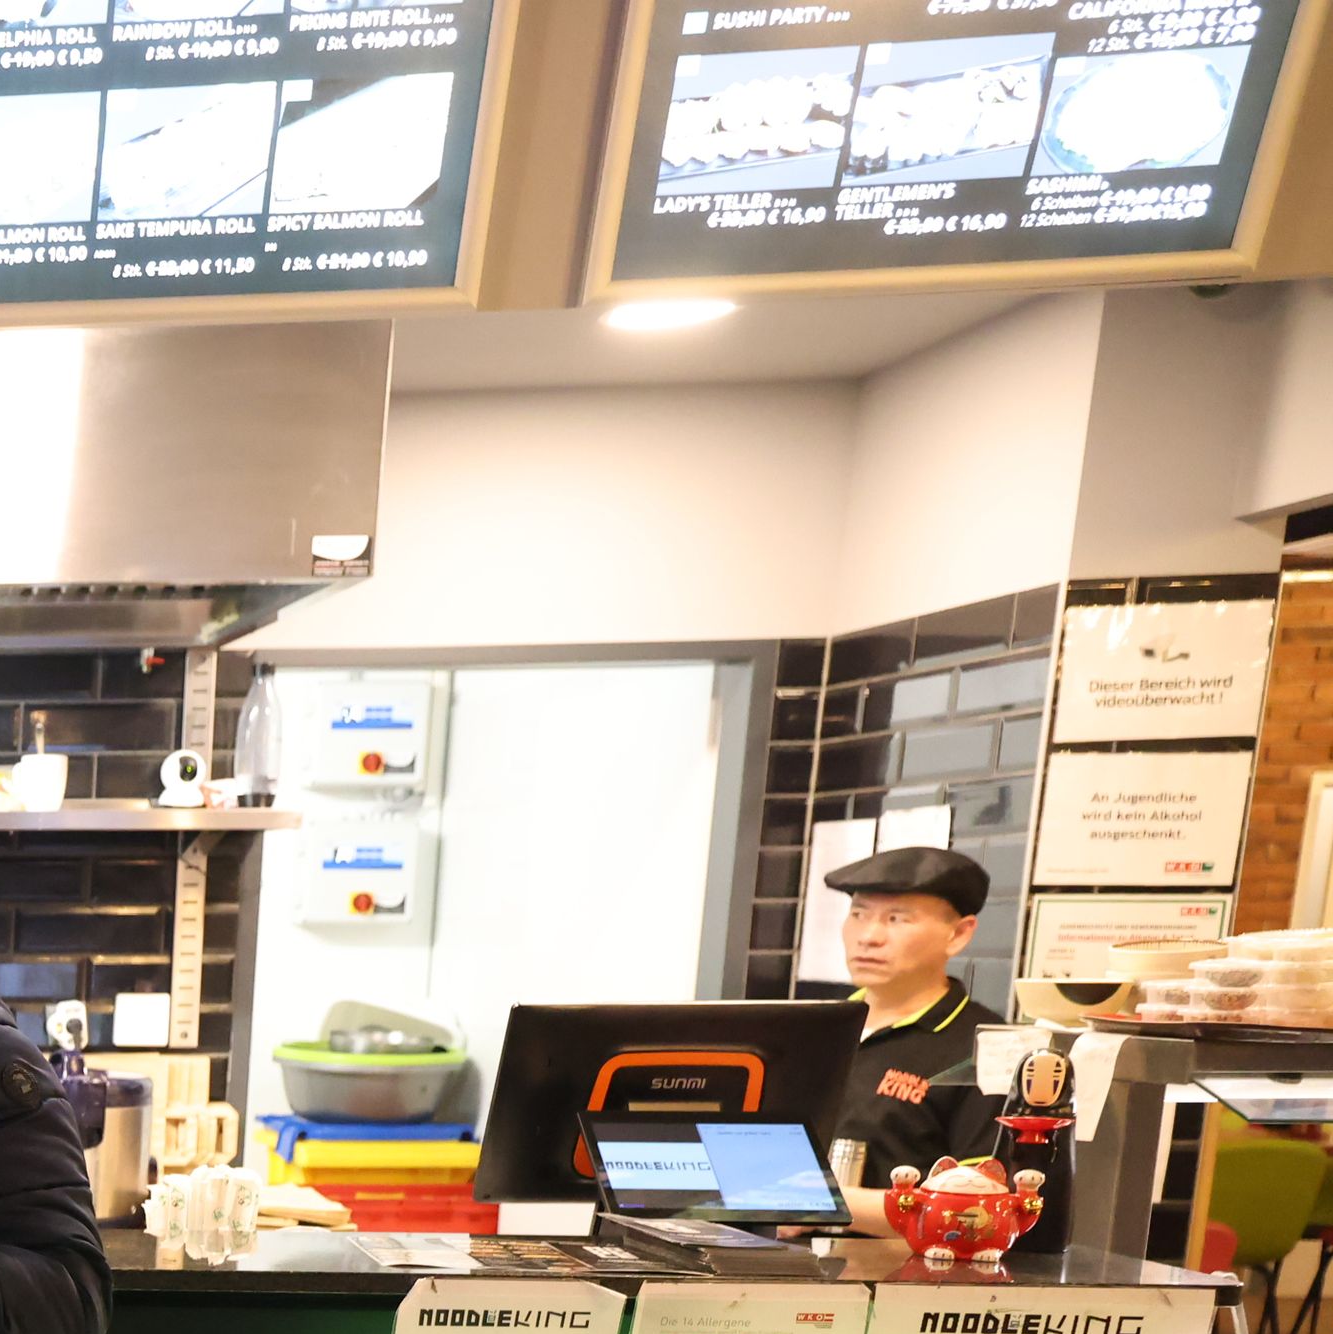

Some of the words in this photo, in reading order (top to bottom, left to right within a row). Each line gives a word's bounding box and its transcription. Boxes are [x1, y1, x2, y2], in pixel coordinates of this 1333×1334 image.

[350, 10, 390, 28] ENTE
[393, 8, 432, 25] ROLL
[713, 9, 765, 30] SUSHI
[769, 6, 827, 26] PARTY
[56, 27, 97, 44] ROLL
[112, 23, 192, 42] RAINBOW
[194, 20, 235, 38] ROLL
[653, 196, 711, 214] LADY'S
[713, 193, 773, 210] TELLER
[835, 203, 893, 220] TELLER
[96, 222, 134, 239] SAKE
[138, 219, 211, 237] TEMPURA
[215, 217, 256, 234] ROLL
[267, 215, 312, 232] SPICY
[313, 212, 381, 230] SALMON
[383, 210, 424, 227] ROLL
[48, 226, 86, 242] ROLL
[1089, 680, 1133, 693] Dieser
[1140, 676, 1195, 691] Bereich
[1200, 675, 1233, 689] wird
[1091, 792, 1109, 803] An
[1114, 792, 1197, 805] Jugendliche
[1082, 811, 1112, 821] wird
[1117, 811, 1146, 820] kein
[1150, 810, 1202, 821] Alkohol
[1090, 829, 1186, 842] ausgeschenkt.
[651, 1077, 706, 1090] SUNMI
[876, 1079, 926, 1105] KING
[660, 1316, 677, 1326] Die
[683, 1317, 694, 1326] 14
[697, 1317, 751, 1329] Allergene
